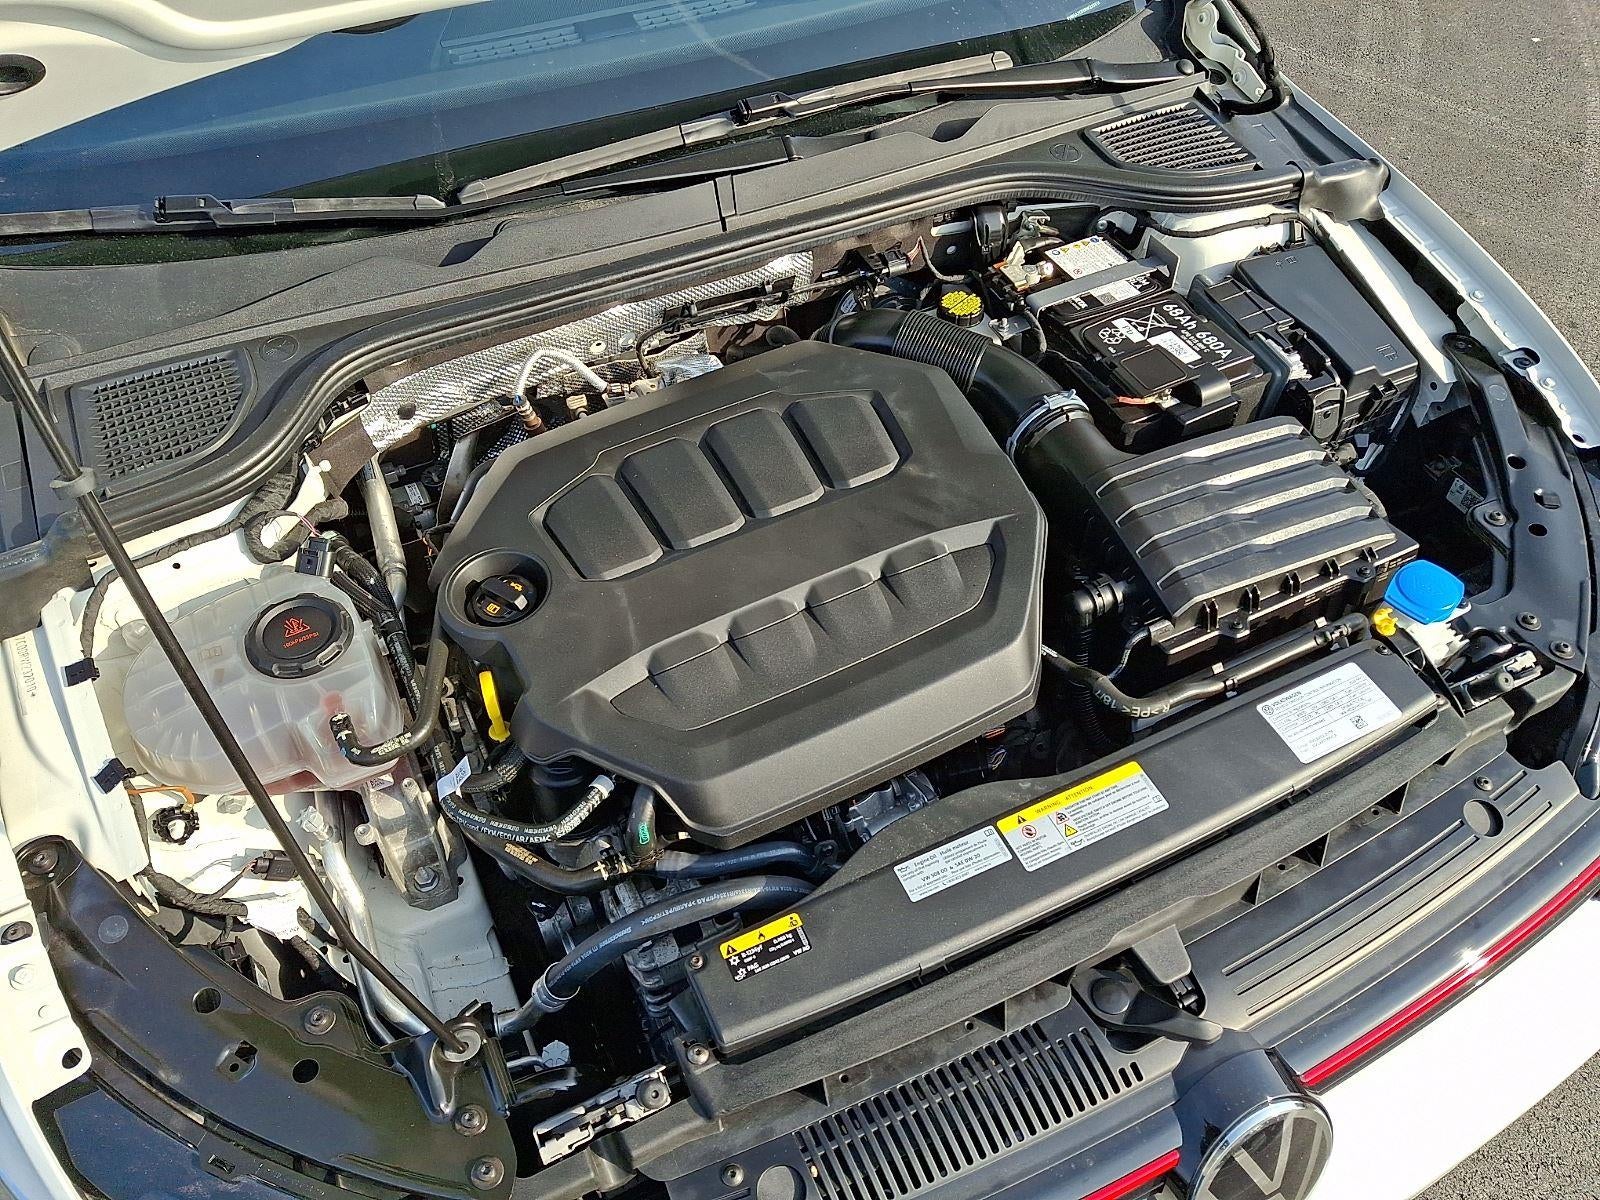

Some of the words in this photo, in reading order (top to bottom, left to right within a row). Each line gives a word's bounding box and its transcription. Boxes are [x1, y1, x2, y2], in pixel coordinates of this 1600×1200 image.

[1162, 304, 1198, 331] 68Ah
[1195, 331, 1233, 359] 680A
[1162, 703, 1170, 713] R
[1034, 800, 1062, 815] WARNING
[1065, 785, 1093, 801] ATTENTION
[940, 847, 952, 856] Huile
[952, 840, 969, 850] moteur
[914, 856, 930, 867] Engine
[929, 853, 937, 861] Oil
[931, 871, 941, 879] 508
[940, 867, 948, 875] 00
[954, 860, 965, 868] SAE
[746, 962, 760, 971] PAG
